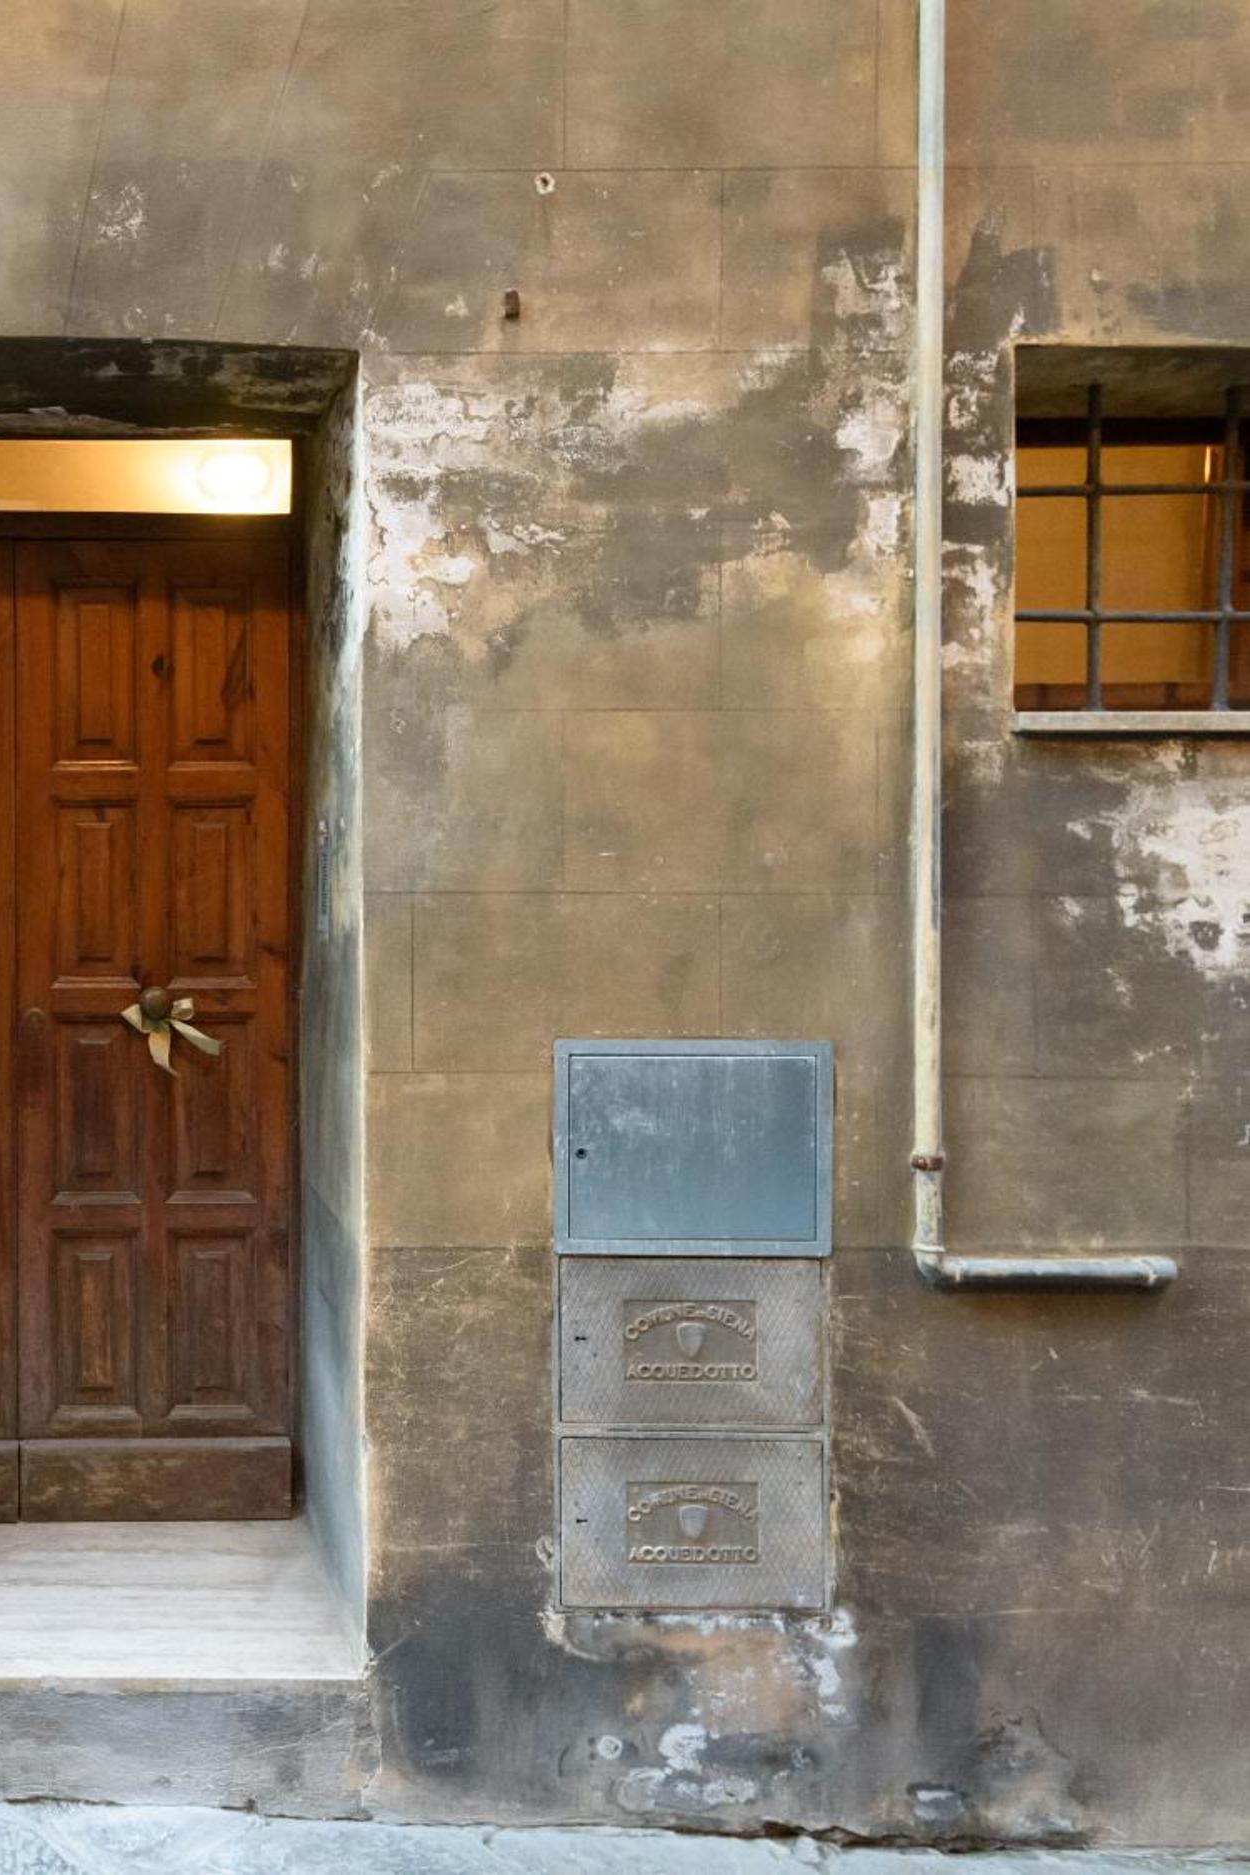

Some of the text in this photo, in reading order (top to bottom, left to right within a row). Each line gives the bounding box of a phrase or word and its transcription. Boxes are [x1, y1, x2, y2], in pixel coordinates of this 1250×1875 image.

[624, 1302, 756, 1341] COMUNE SIENA
[626, 1363, 756, 1379] ACQUEDOTTO
[628, 1545, 757, 1561] ACQUEDOTTO
